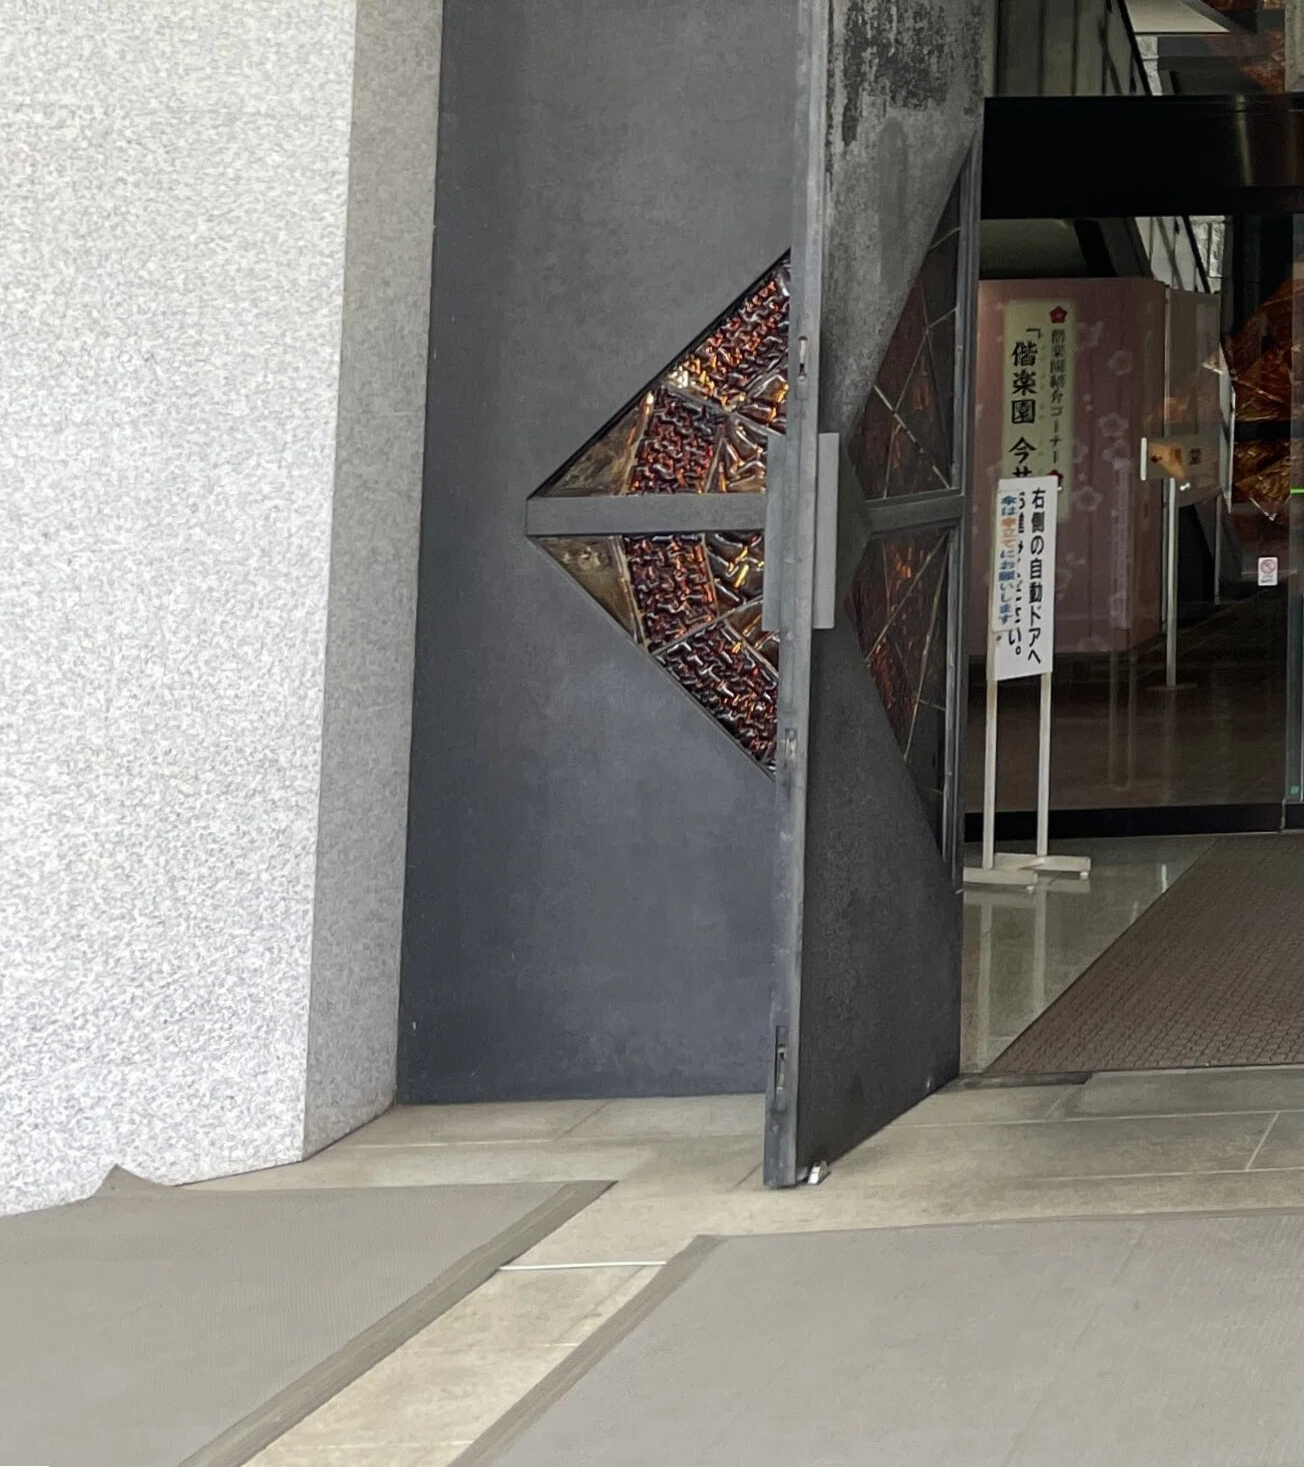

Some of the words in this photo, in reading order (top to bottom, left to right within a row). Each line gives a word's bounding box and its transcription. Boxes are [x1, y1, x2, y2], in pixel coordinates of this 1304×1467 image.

[1027, 488, 1047, 664] 右側の自動ドアへ
